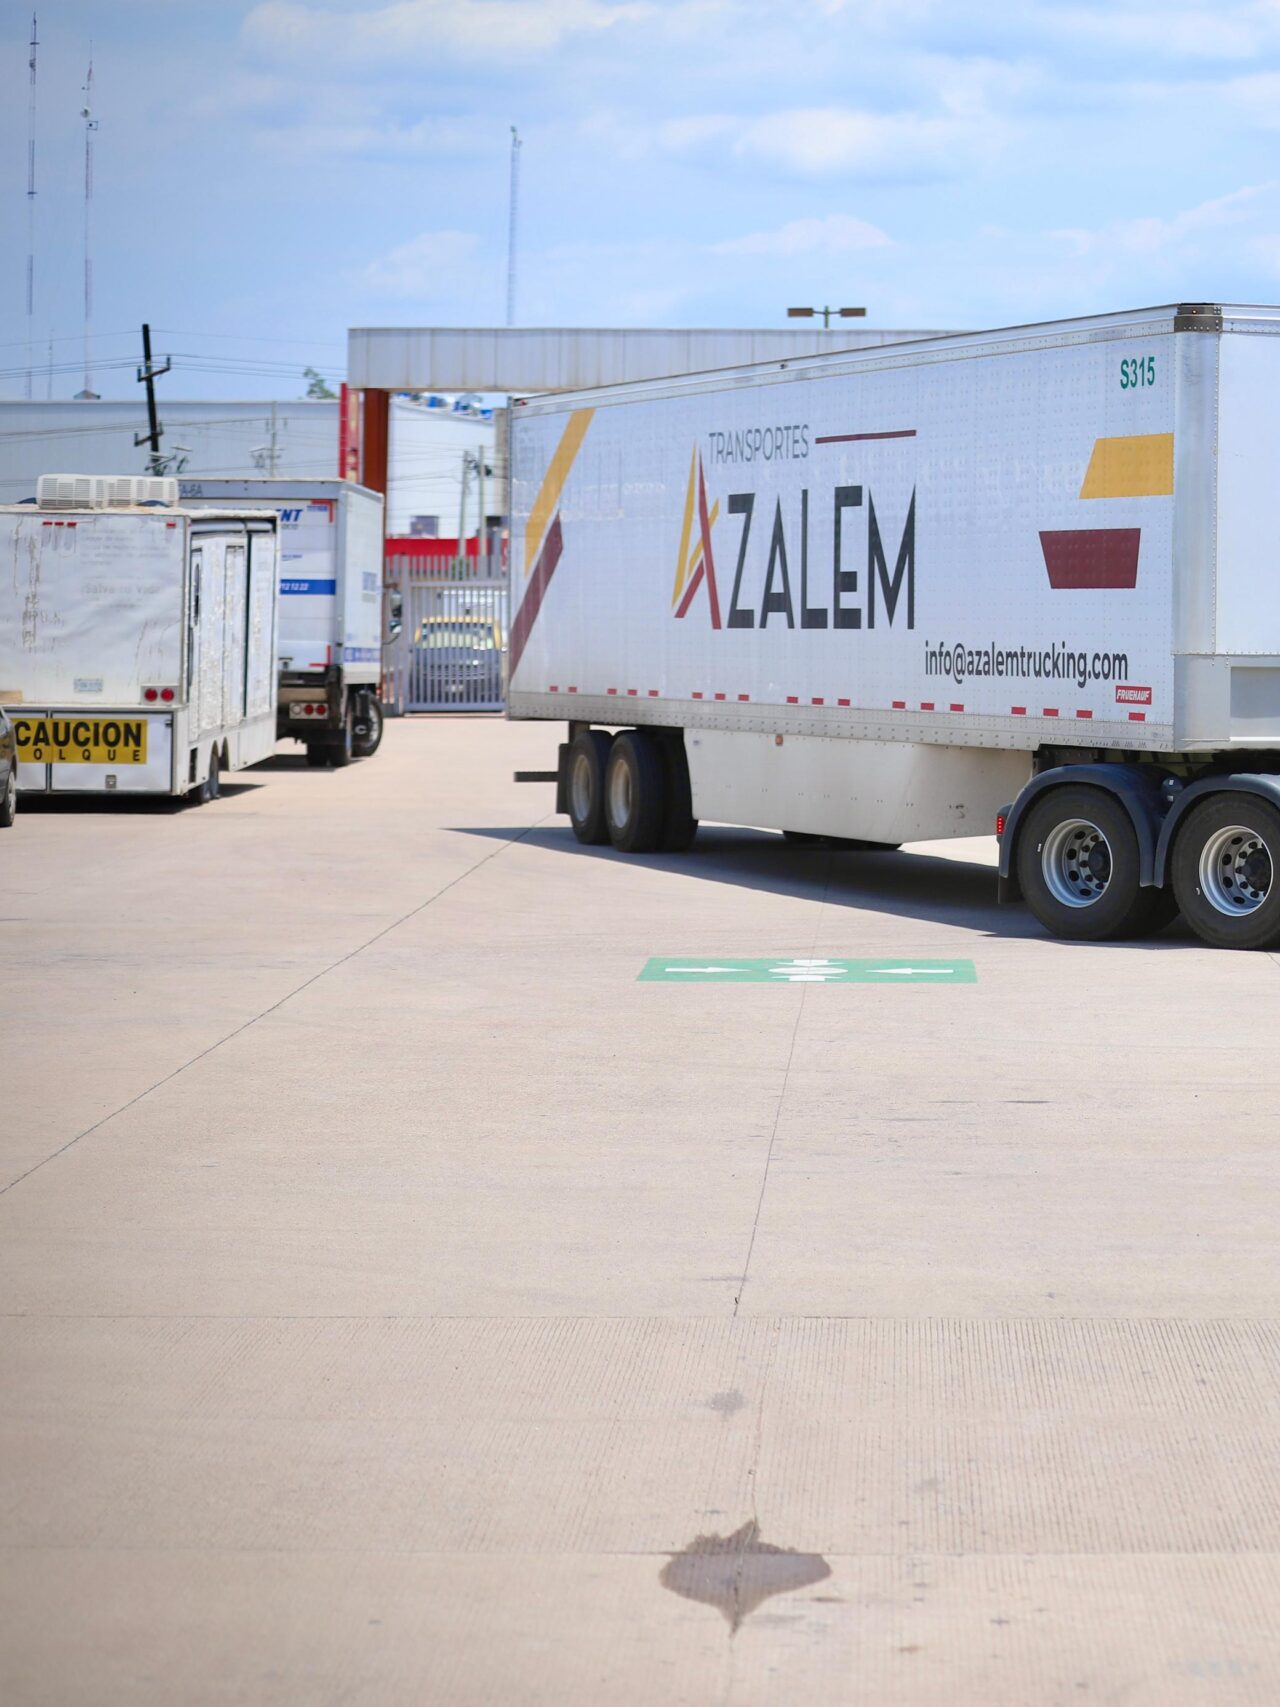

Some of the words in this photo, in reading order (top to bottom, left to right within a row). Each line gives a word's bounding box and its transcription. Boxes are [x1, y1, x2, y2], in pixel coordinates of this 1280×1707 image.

[1120, 356, 1155, 389] S315
[708, 424, 810, 465] TRANSPORTES
[671, 438, 916, 630] AZALEM
[925, 640, 1128, 688] info@azalemtrucking.com
[1116, 688, 1151, 702] FRUEHAUF
[15, 720, 142, 748] CAUCION
